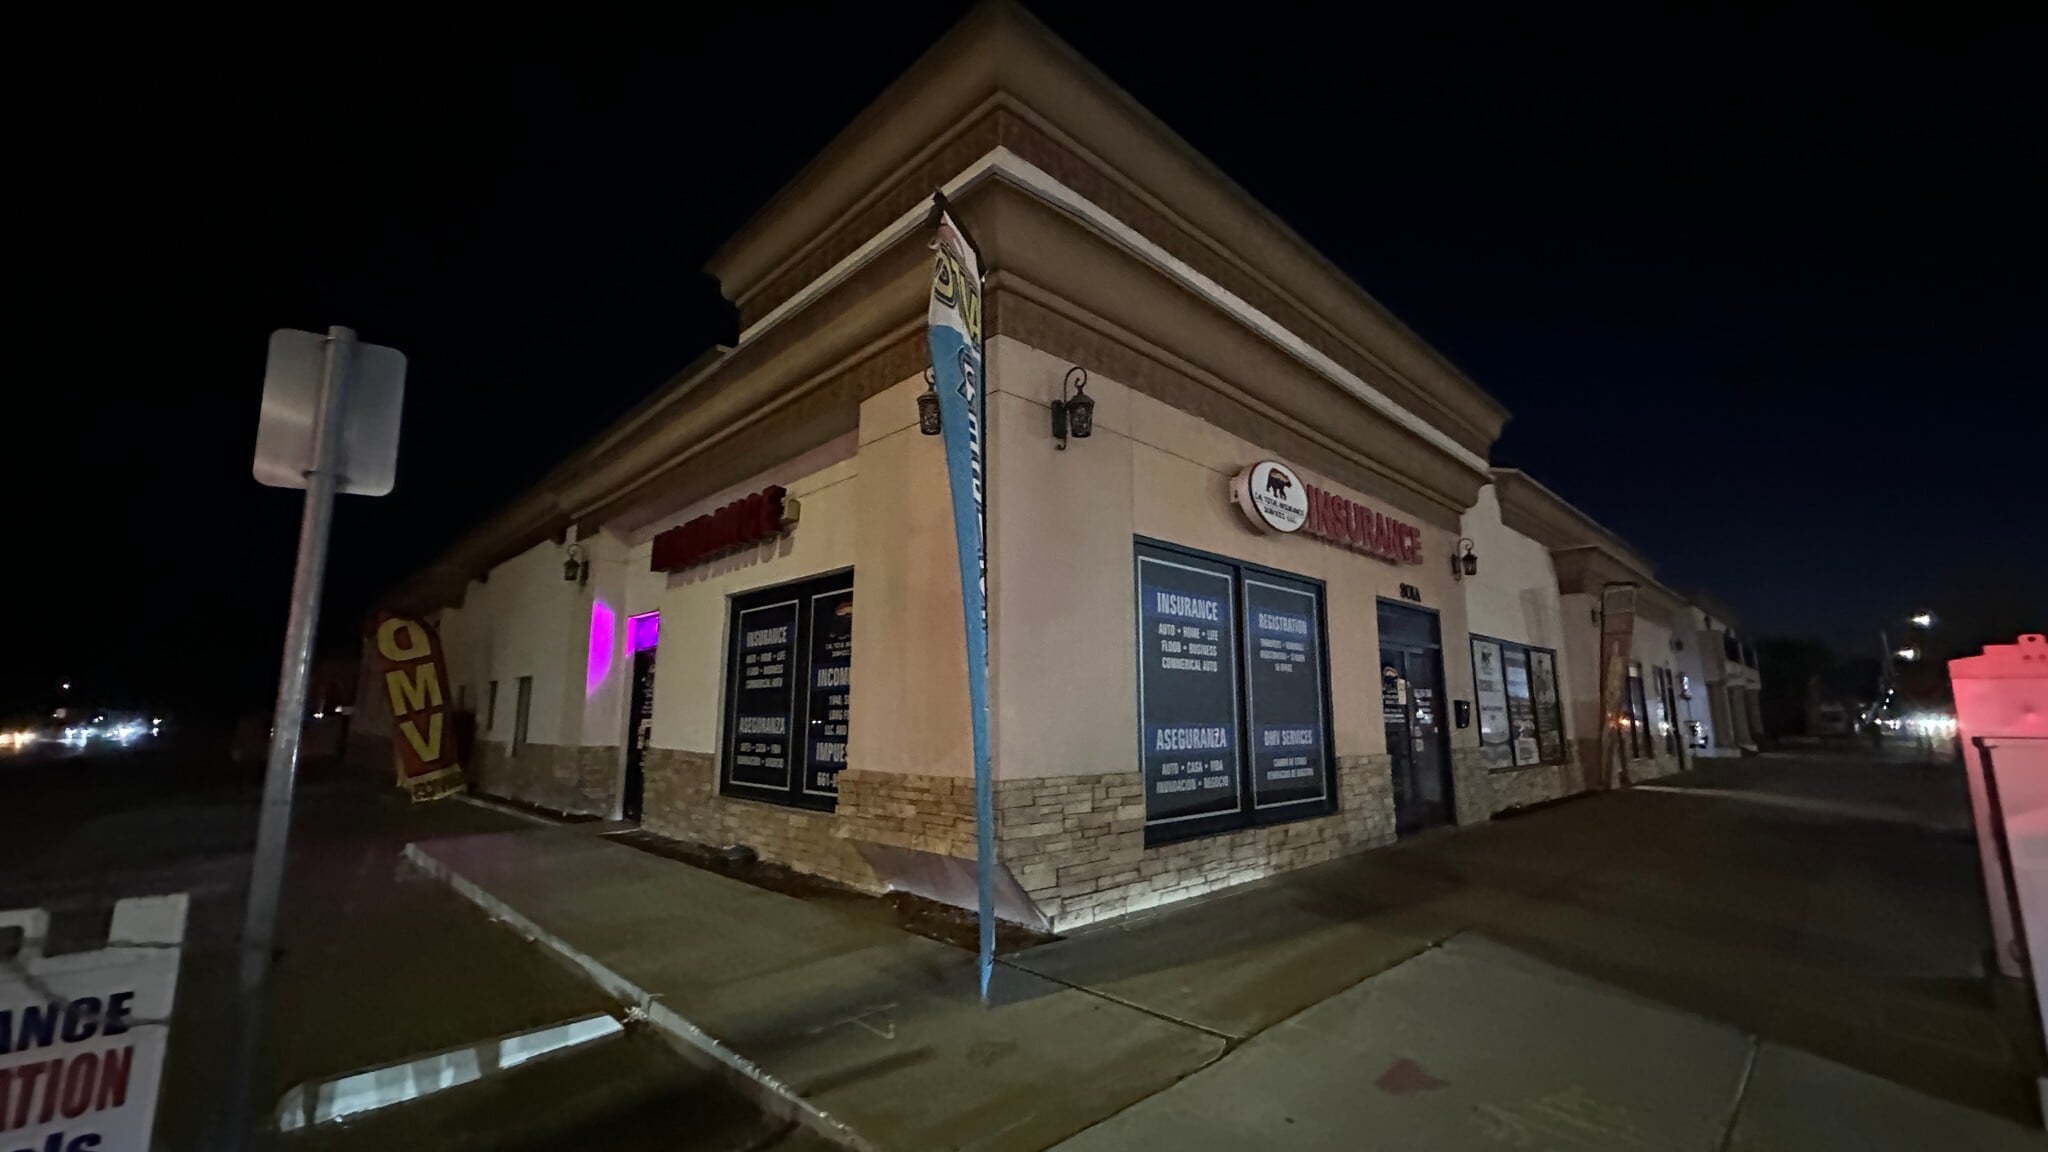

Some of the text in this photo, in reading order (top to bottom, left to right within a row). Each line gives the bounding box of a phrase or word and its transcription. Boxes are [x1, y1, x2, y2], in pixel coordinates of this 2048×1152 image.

[1306, 484, 1424, 565] INSURANCE
[1157, 592, 1219, 621] INSURANCE
[1159, 623, 1175, 636] AUTO
[1259, 613, 1307, 635] REGISTRATION
[1161, 640, 1181, 653] FLOOD
[1156, 728, 1227, 750] ASEGURANZA
[1282, 730, 1313, 745] SERVICES
[1162, 763, 1178, 776] AUTO
